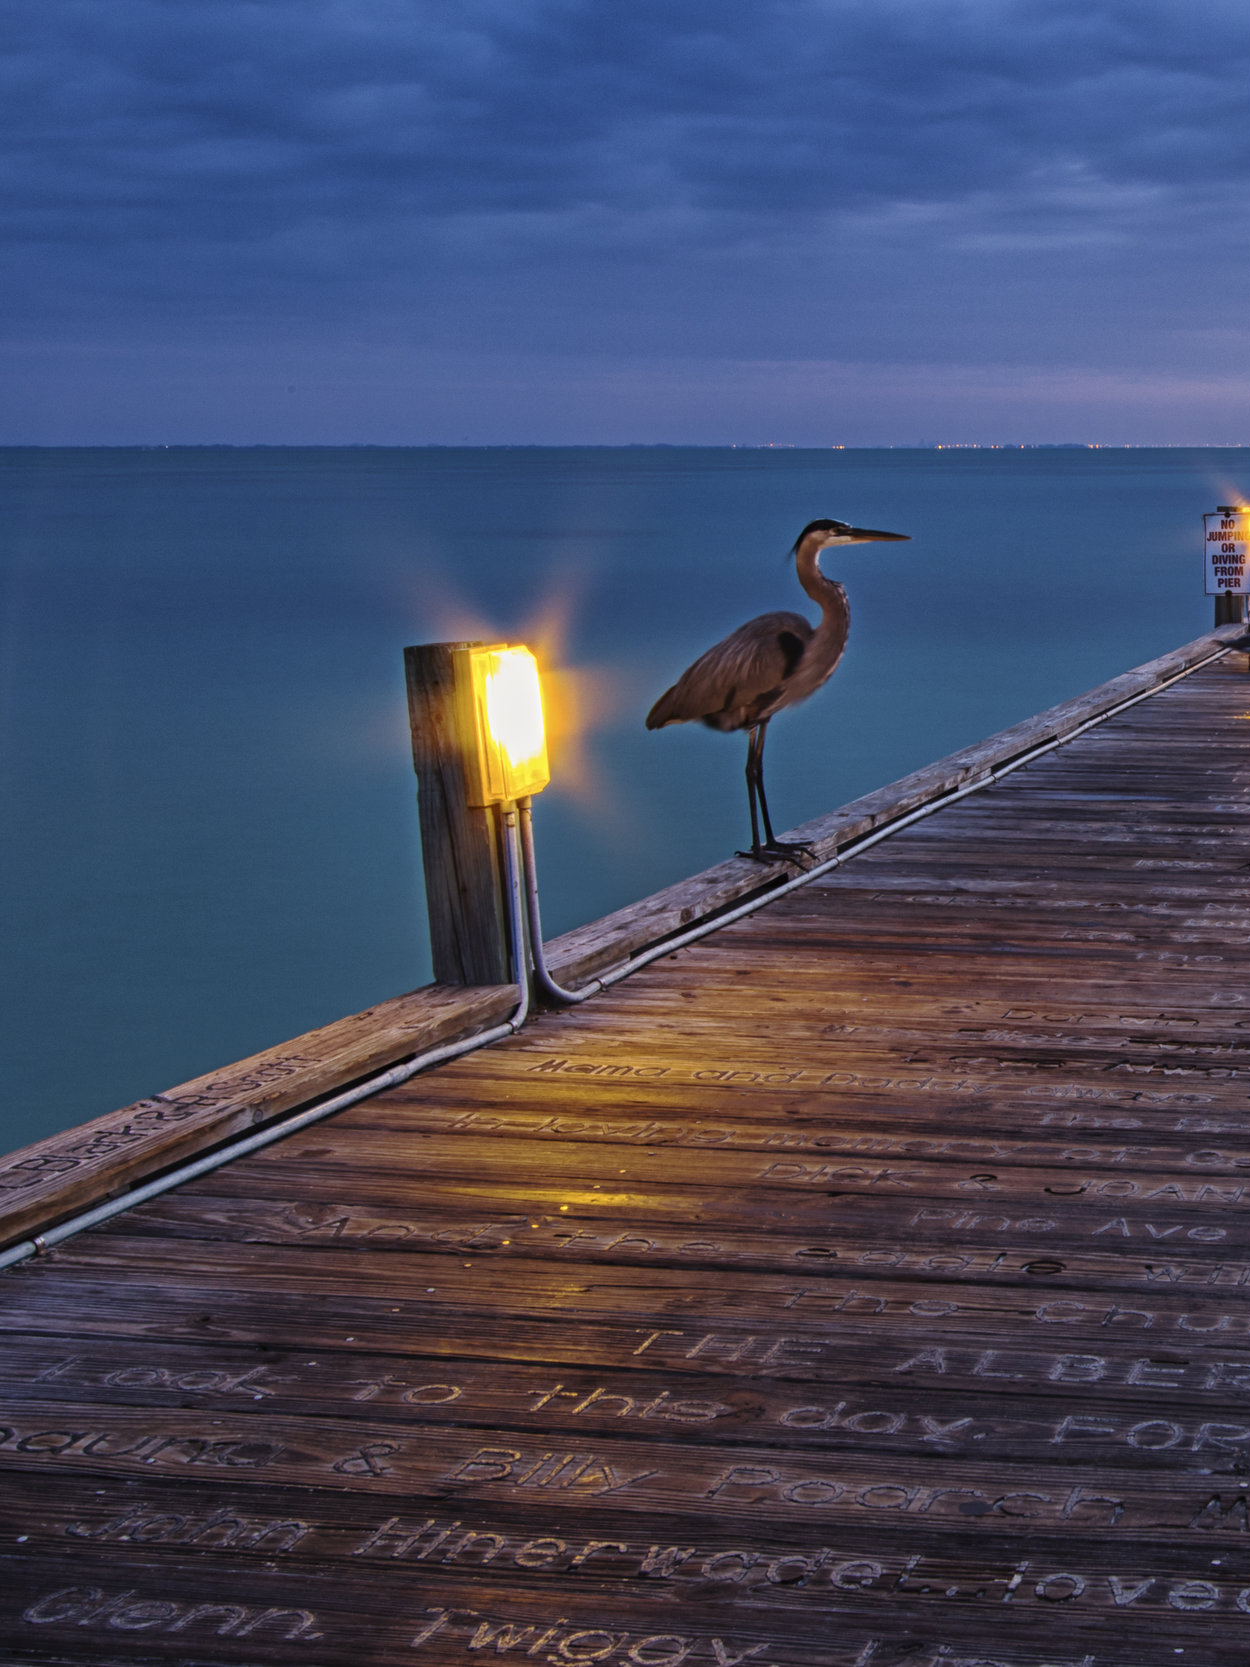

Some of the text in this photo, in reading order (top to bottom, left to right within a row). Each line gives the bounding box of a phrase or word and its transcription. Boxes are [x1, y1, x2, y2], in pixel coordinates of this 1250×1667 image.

[1207, 532, 1250, 541] JUMPING
[1221, 520, 1235, 529] NO
[1212, 555, 1246, 564] DIVING
[1221, 543, 1235, 553] OR
[1214, 566, 1243, 576] FROM
[1218, 578, 1241, 588] PIER
[526, 1059, 671, 1077] Mama
[693, 1070, 803, 1083] and
[819, 1072, 997, 1094] Daddy
[447, 1112, 505, 1130] In
[532, 1117, 736, 1144] loving
[764, 1132, 1026, 1158] memory
[1061, 1146, 1153, 1163] of
[958, 1173, 998, 1191] &
[1044, 1179, 1244, 1202] JOAN
[910, 1208, 1058, 1233] Pine
[1092, 1217, 1227, 1241] Ave
[297, 1217, 495, 1244] And
[553, 1229, 720, 1254] the
[795, 1247, 1067, 1275] eagle
[785, 1286, 959, 1316] The
[632, 1328, 830, 1365] THE
[333, 1440, 401, 1476] &
[448, 1447, 658, 1497] Billy
[706, 1466, 1126, 1525] Poarch
[65, 1502, 311, 1552] John
